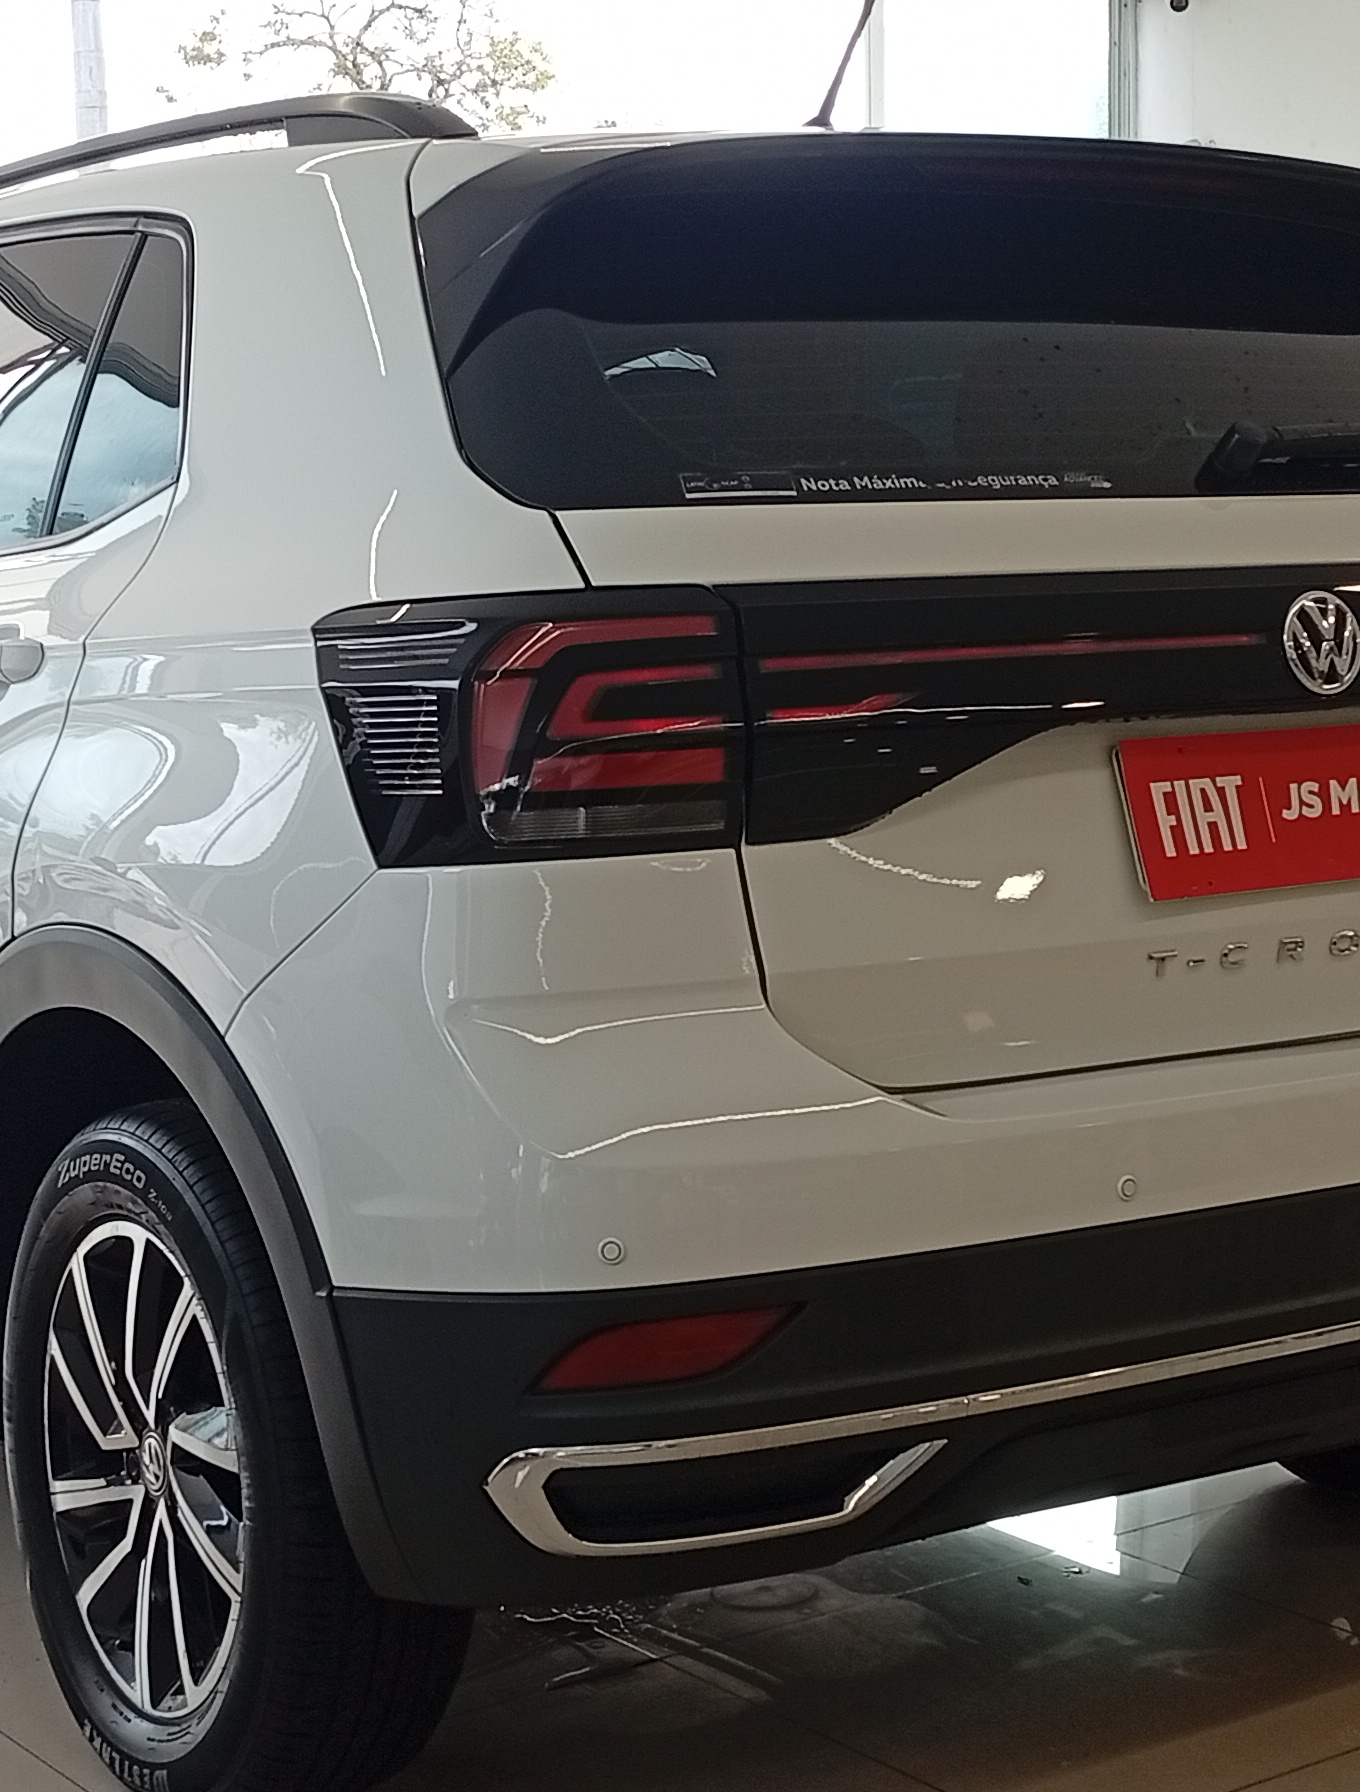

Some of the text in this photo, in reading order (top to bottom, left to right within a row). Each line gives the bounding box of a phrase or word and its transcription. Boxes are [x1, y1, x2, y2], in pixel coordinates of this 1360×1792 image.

[799, 476, 852, 492] Nota
[1149, 774, 1248, 858] FIAT
[1281, 780, 1324, 821] JS
[56, 1152, 147, 1189] ZuperEco
